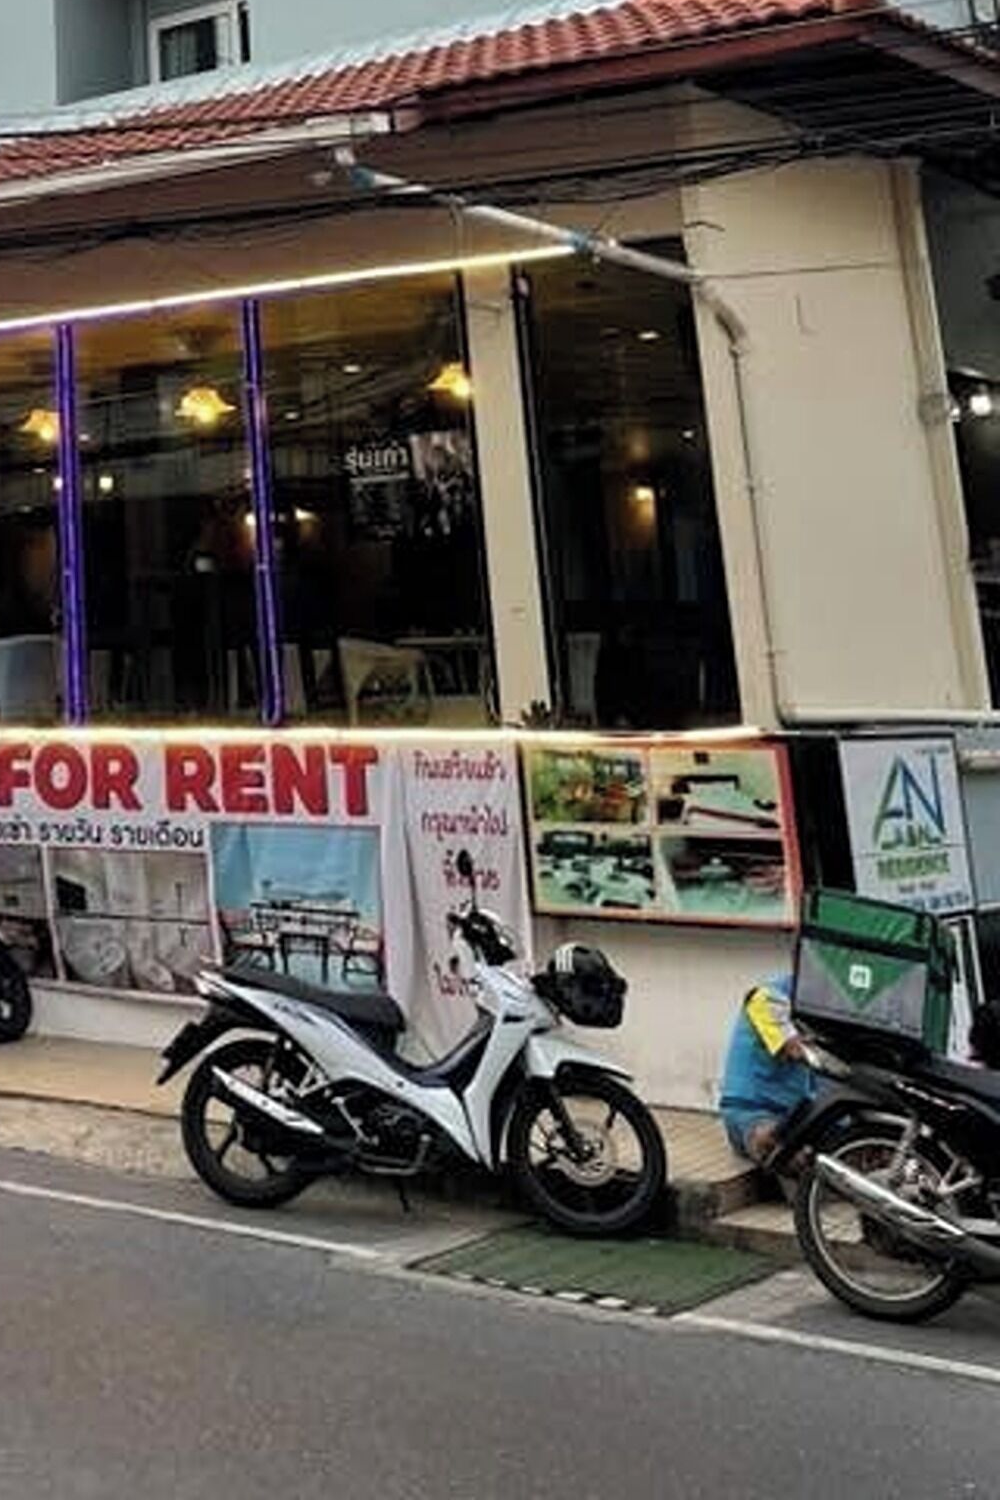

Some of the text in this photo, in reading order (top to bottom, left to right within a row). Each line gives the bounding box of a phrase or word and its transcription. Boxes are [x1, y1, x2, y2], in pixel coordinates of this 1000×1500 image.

[165, 743, 379, 816] RENT
[40, 817, 101, 844] รายวัน
[111, 820, 204, 848] รายเดือน
